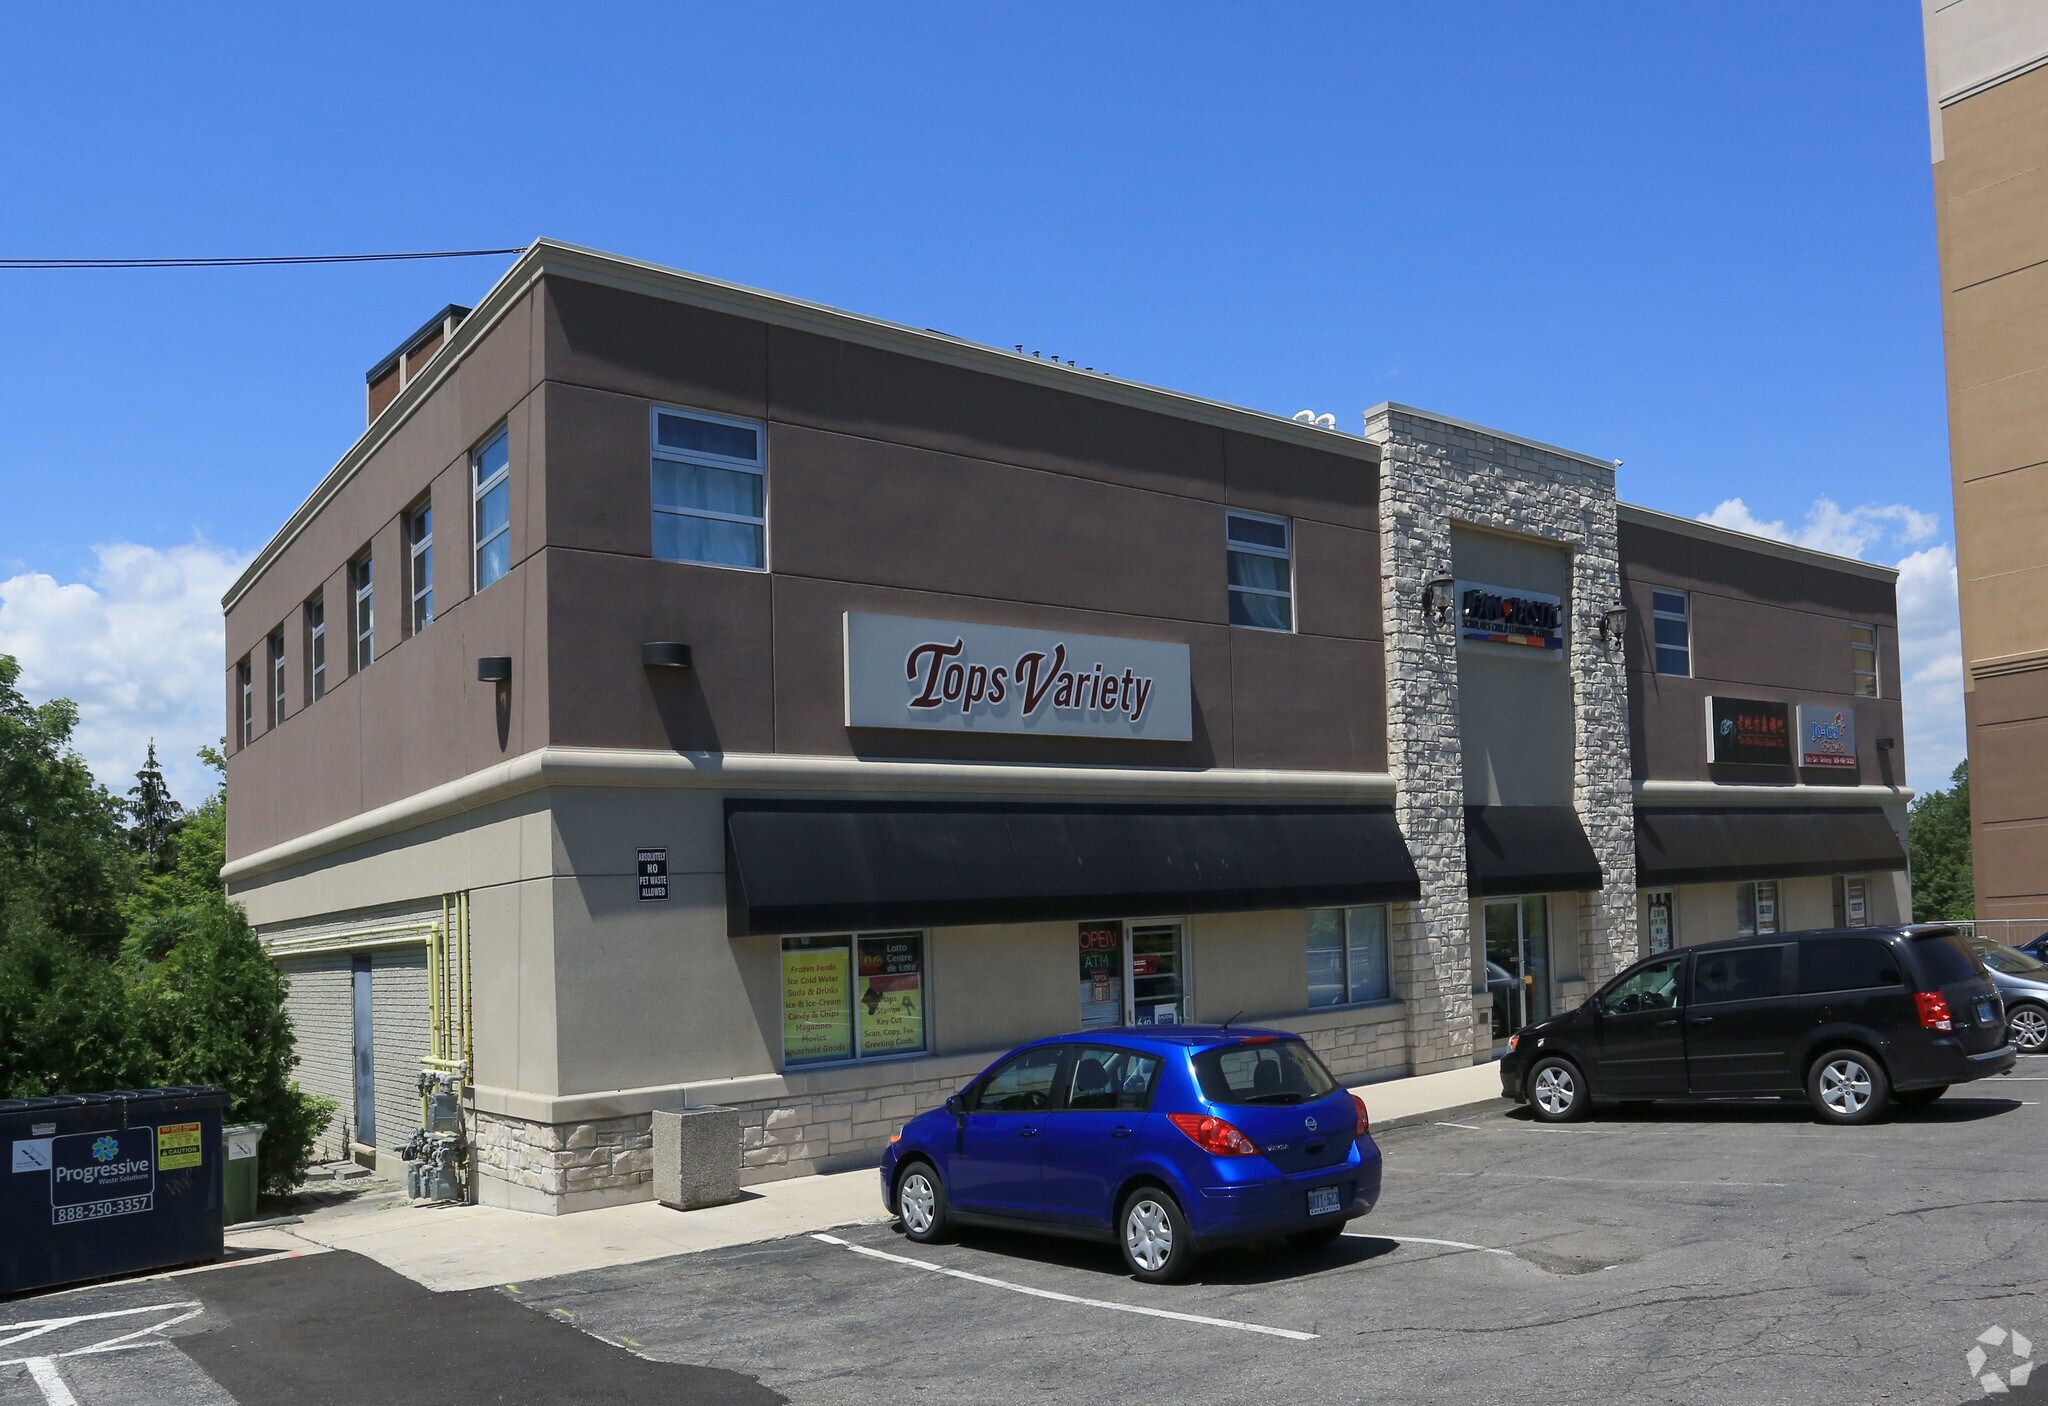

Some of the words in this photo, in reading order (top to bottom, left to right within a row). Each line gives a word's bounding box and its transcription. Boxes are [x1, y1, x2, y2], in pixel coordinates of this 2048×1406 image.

[906, 635, 1008, 715] Tops
[1013, 641, 1152, 723] Variety
[638, 852, 666, 861] ABSOLUTELY
[647, 864, 658, 873] NO
[639, 876, 649, 885] PET
[650, 876, 667, 885] WASTE
[642, 887, 666, 897] ALLOWED
[1080, 930, 1118, 948] OPEN
[887, 944, 907, 953] Lotto
[887, 954, 913, 963] Centre
[1085, 955, 1109, 968] ATM
[816, 963, 836, 972] Foods
[887, 964, 897, 973] de
[899, 963, 917, 972] Loto
[800, 976, 817, 985] Cold
[818, 975, 839, 983] Water
[788, 989, 806, 997] Soda
[807, 988, 814, 996] &
[816, 986, 839, 995] Drinks
[785, 1001, 796, 1009] Ice
[798, 1000, 804, 1008] &
[806, 998, 841, 1007] Ice-Cream
[788, 1012, 809, 1021] Candy
[812, 1010, 818, 1019] &
[820, 1009, 840, 1019] Chips
[877, 1007, 901, 1015] Stamps
[877, 1018, 889, 1027] Key
[891, 1016, 902, 1024] Cut
[796, 1023, 833, 1032] Magazines
[903, 1026, 914, 1034] Fax
[822, 1043, 846, 1053] Goods
[865, 1040, 895, 1049] Greeting
[895, 1037, 914, 1046] Cards
[168, 1146, 197, 1156] CAUTION
[56, 1159, 149, 1183] Progressive
[119, 1173, 149, 1183] Solutions
[58, 1197, 148, 1222] 888-250-3357
